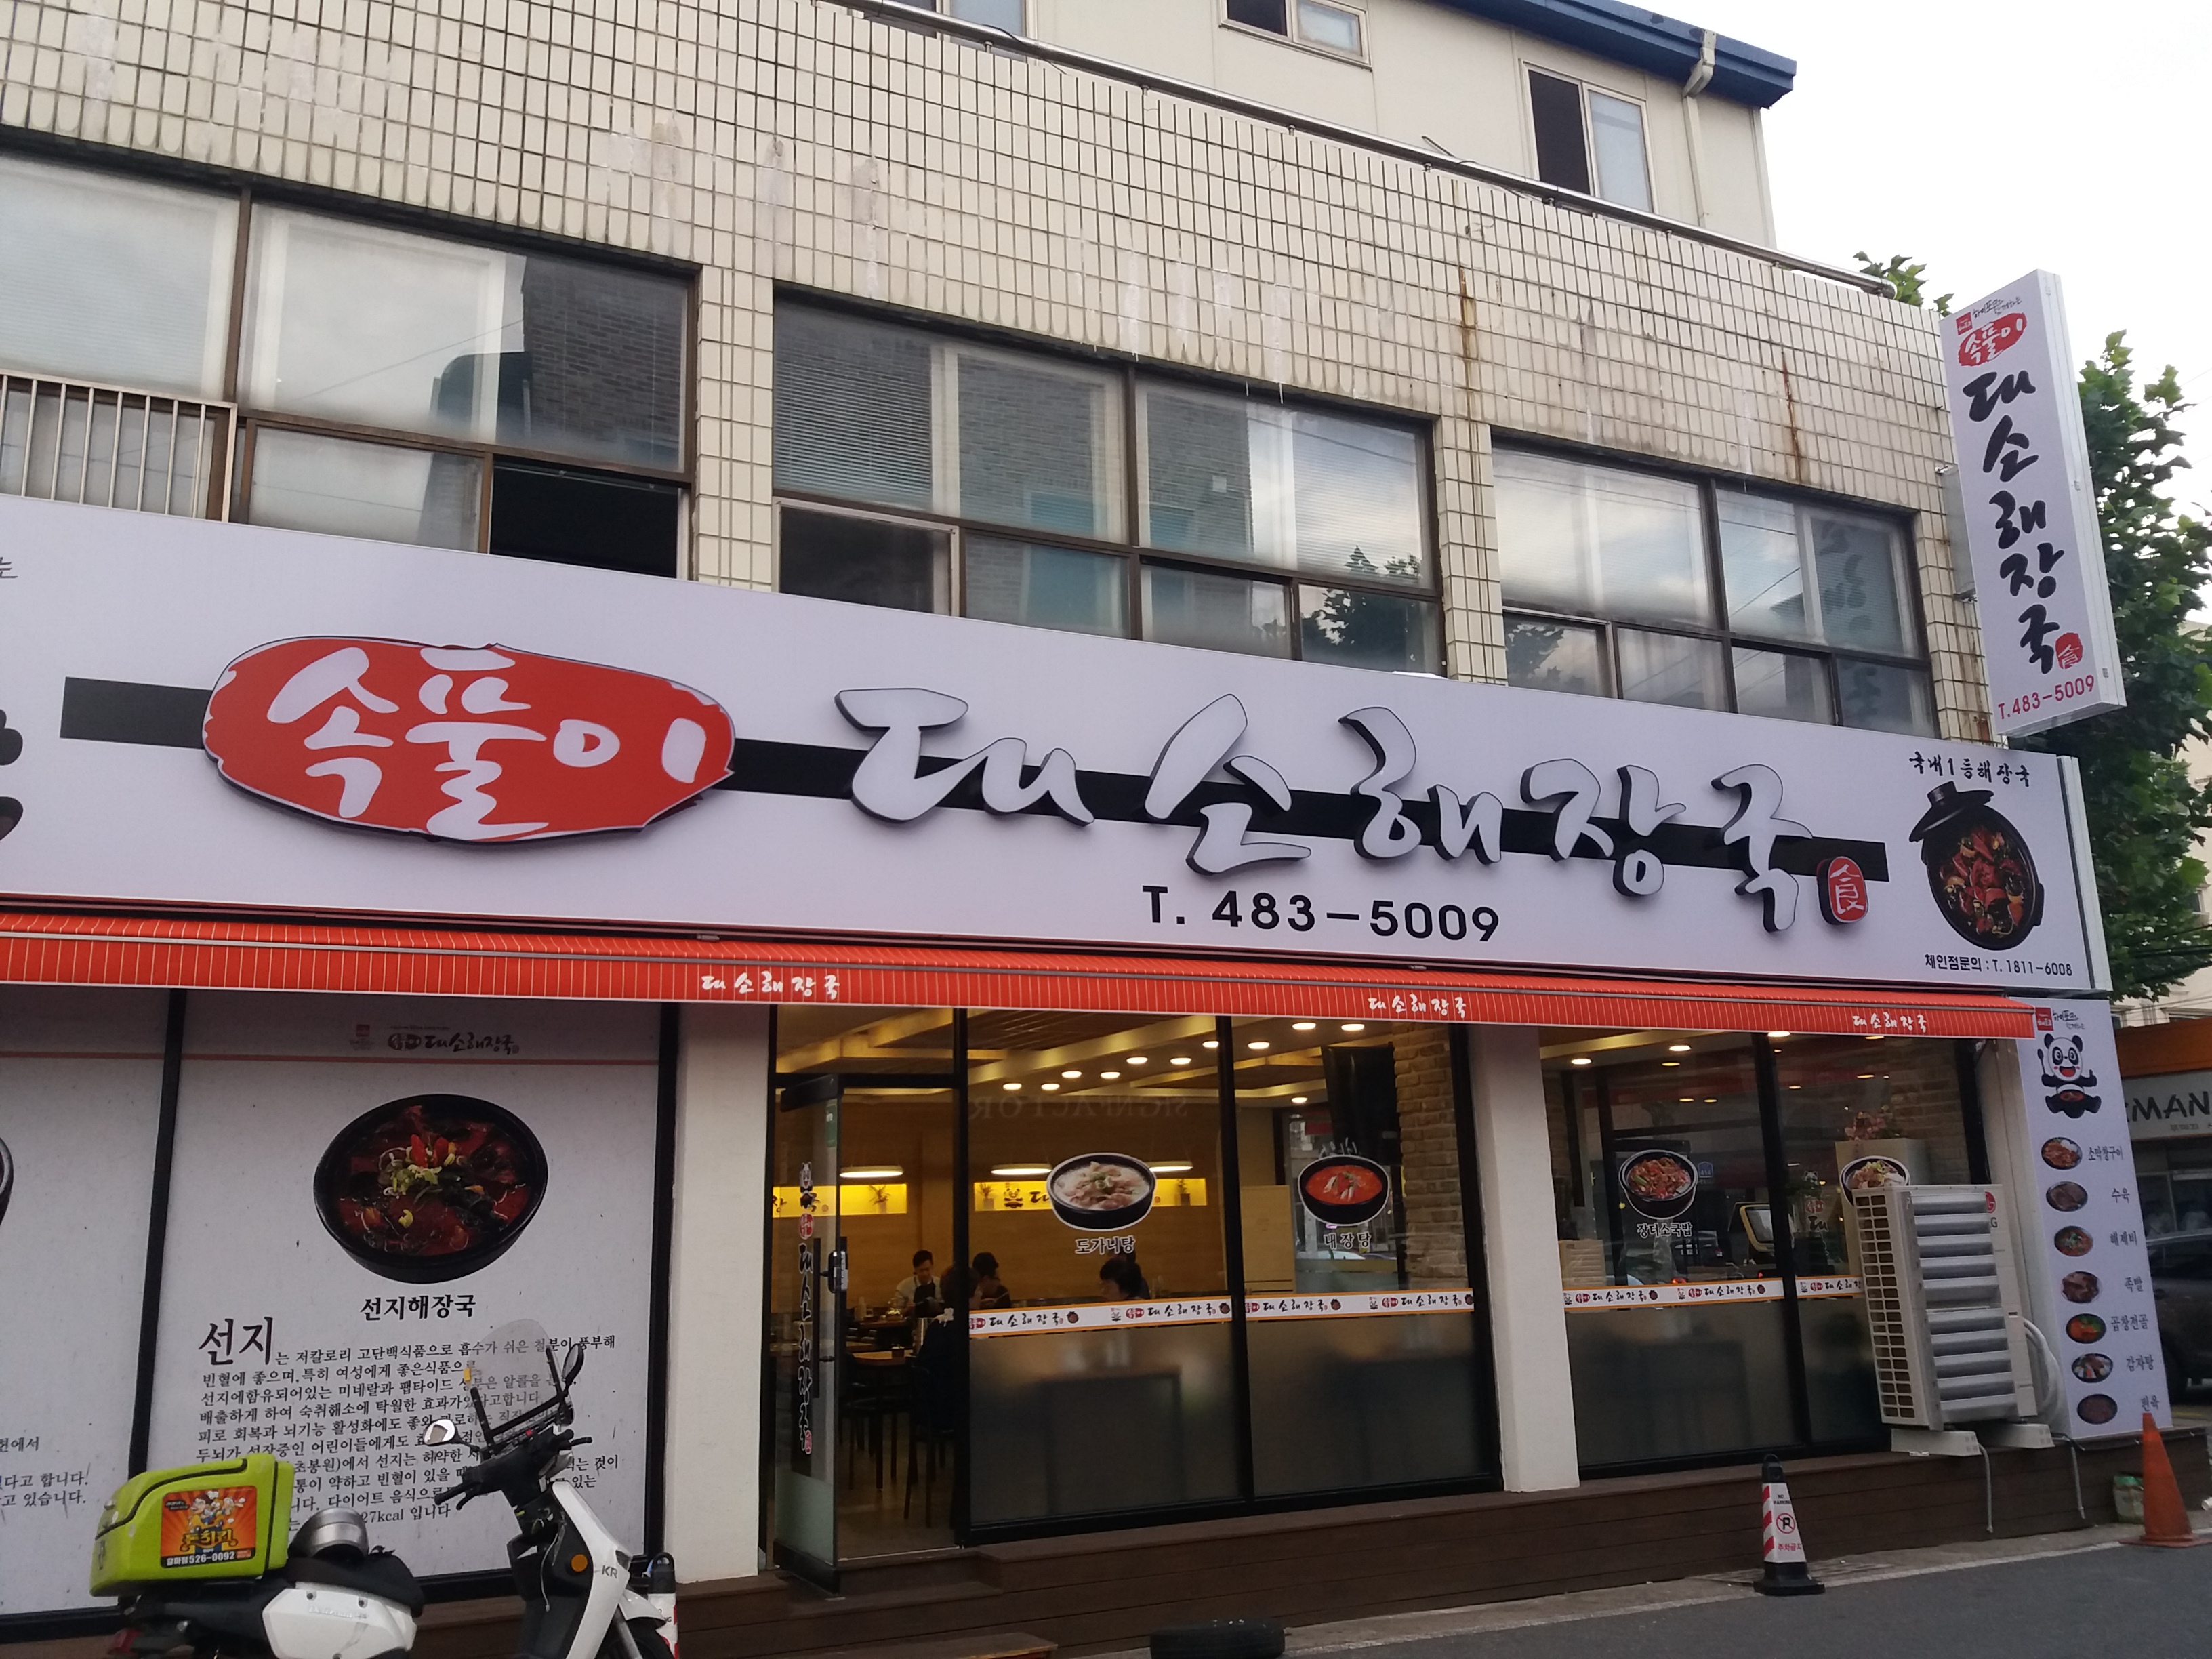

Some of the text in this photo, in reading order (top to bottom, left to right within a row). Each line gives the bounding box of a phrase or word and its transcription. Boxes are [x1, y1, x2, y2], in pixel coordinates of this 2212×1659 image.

[1965, 318, 2023, 364] 속풀이
[267, 647, 707, 841] 속풀이
[1143, 884, 1499, 943] T. 483-5009
[2110, 1187, 2131, 1204] 수육
[1637, 1222, 1693, 1239] 장터소국밥
[1075, 1235, 1136, 1255] 도가니탕
[2125, 1275, 2144, 1293] 족발
[360, 1294, 476, 1321] 선지해장국
[2110, 1313, 2149, 1332] 곱창전골
[296, 1347, 352, 1364] 저칼로리
[357, 1343, 453, 1361] 고단백식품으로
[458, 1340, 498, 1357] 흡수가
[203, 1371, 246, 1388] 빈혈에
[335, 1363, 391, 1380] 여성에게
[338, 1380, 394, 1397] 미네랄과
[200, 1409, 258, 1426] 배출하게
[264, 1406, 293, 1421] 하여
[375, 1398, 417, 1414] 탁월한
[197, 1428, 227, 1444] 피로
[233, 1425, 279, 1441] 회복과
[284, 1422, 327, 1437] 뇌기능
[331, 1417, 403, 1435] 활성화에도
[311, 1434, 409, 1454] 어린이들에게도
[375, 1452, 422, 1469] 선지는
[329, 1473, 370, 1490] 약하고
[377, 1469, 417, 1486] 빈혈이
[424, 1467, 450, 1483] 있을
[594, 1454, 618, 1470] 것이
[328, 1490, 389, 1507] 다이어트
[411, 1503, 451, 1521] 입니다
[601, 1565, 618, 1578] KR
